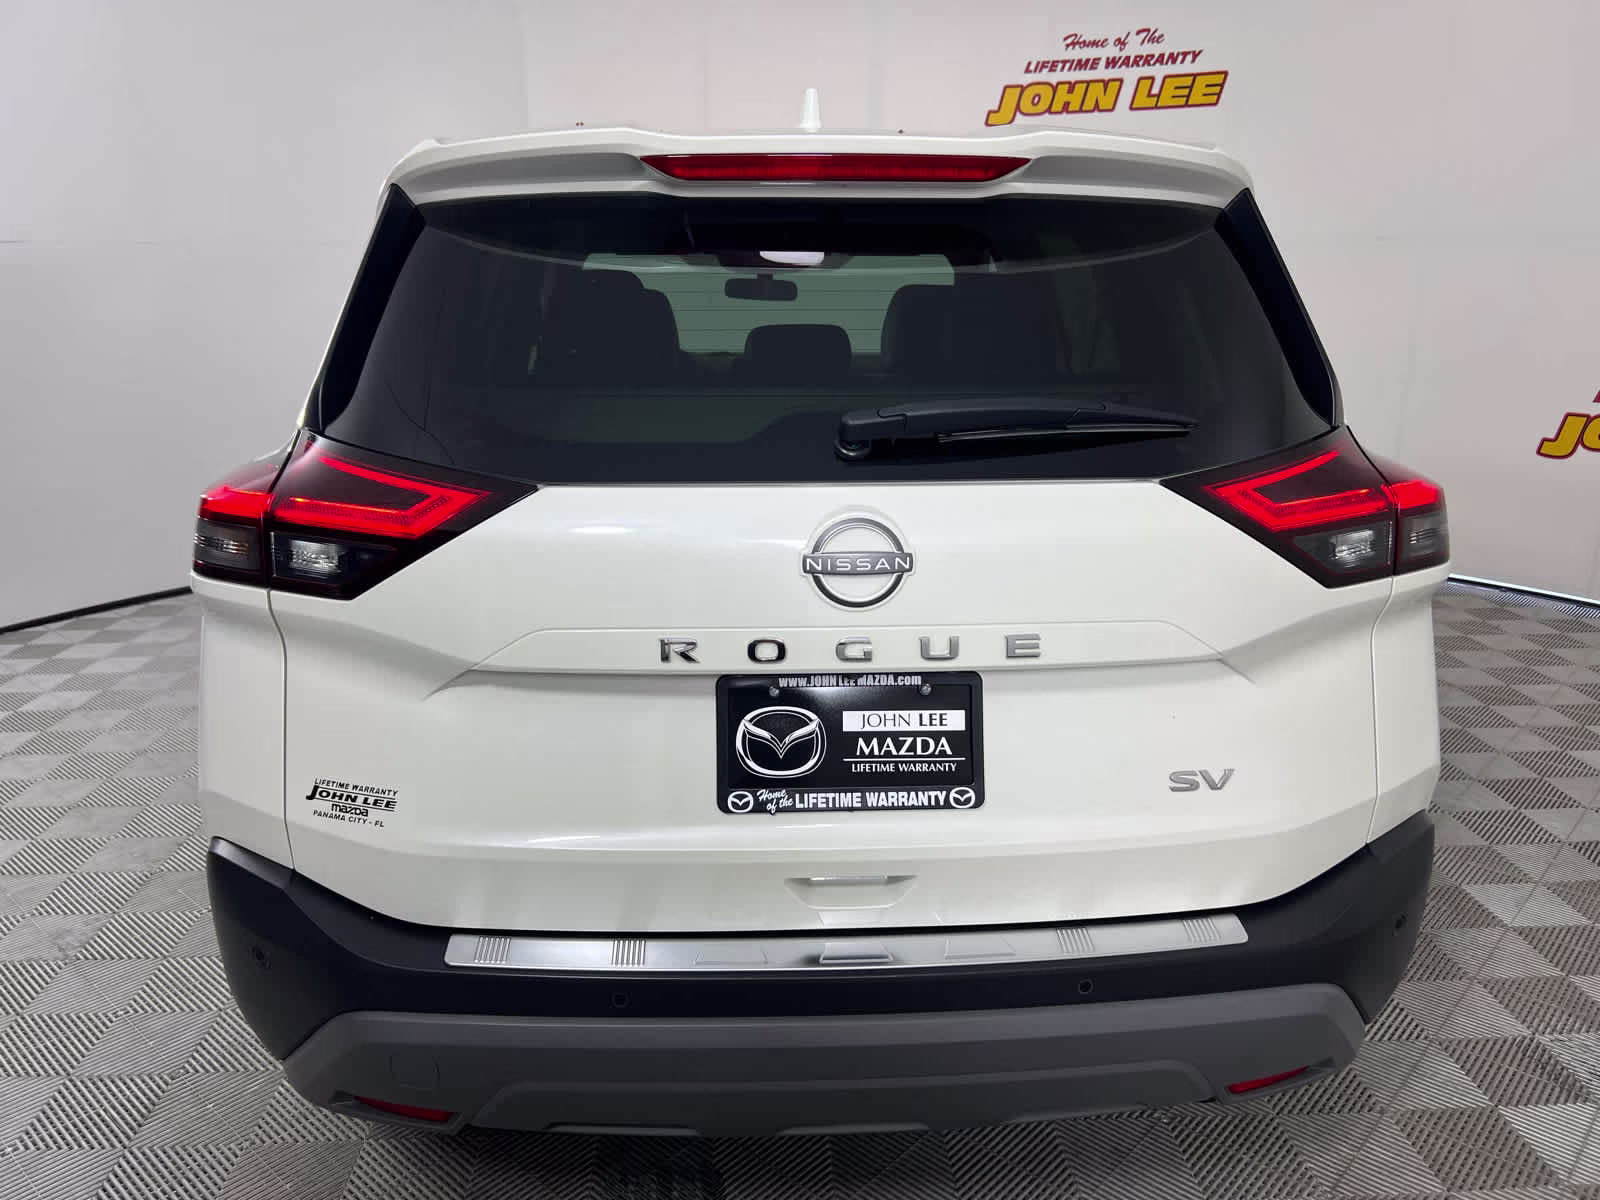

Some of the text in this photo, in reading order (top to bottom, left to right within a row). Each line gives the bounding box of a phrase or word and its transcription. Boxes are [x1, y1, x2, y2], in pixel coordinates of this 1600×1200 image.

[1063, 28, 1164, 52] Home of The
[1024, 50, 1203, 74] LIFETIME WARRANTY
[985, 71, 1228, 127] JOHN LEE
[805, 555, 912, 572] NISSAN
[659, 633, 1042, 664] ROGUE
[861, 713, 948, 729] JOHN LEE
[856, 736, 953, 756] MAZDA
[851, 762, 957, 772] LIFETIME WARRANTY
[314, 778, 398, 797] LIFETIME WARRANTY
[1169, 768, 1235, 792] SV
[305, 784, 397, 809] JOHN LEE
[757, 789, 787, 802] Home
[766, 795, 794, 814] of the
[795, 790, 947, 808] LIFETIME WARRANTY
[312, 809, 346, 822] PANAMA
[348, 816, 368, 825] CITY
[374, 820, 385, 828] FL
